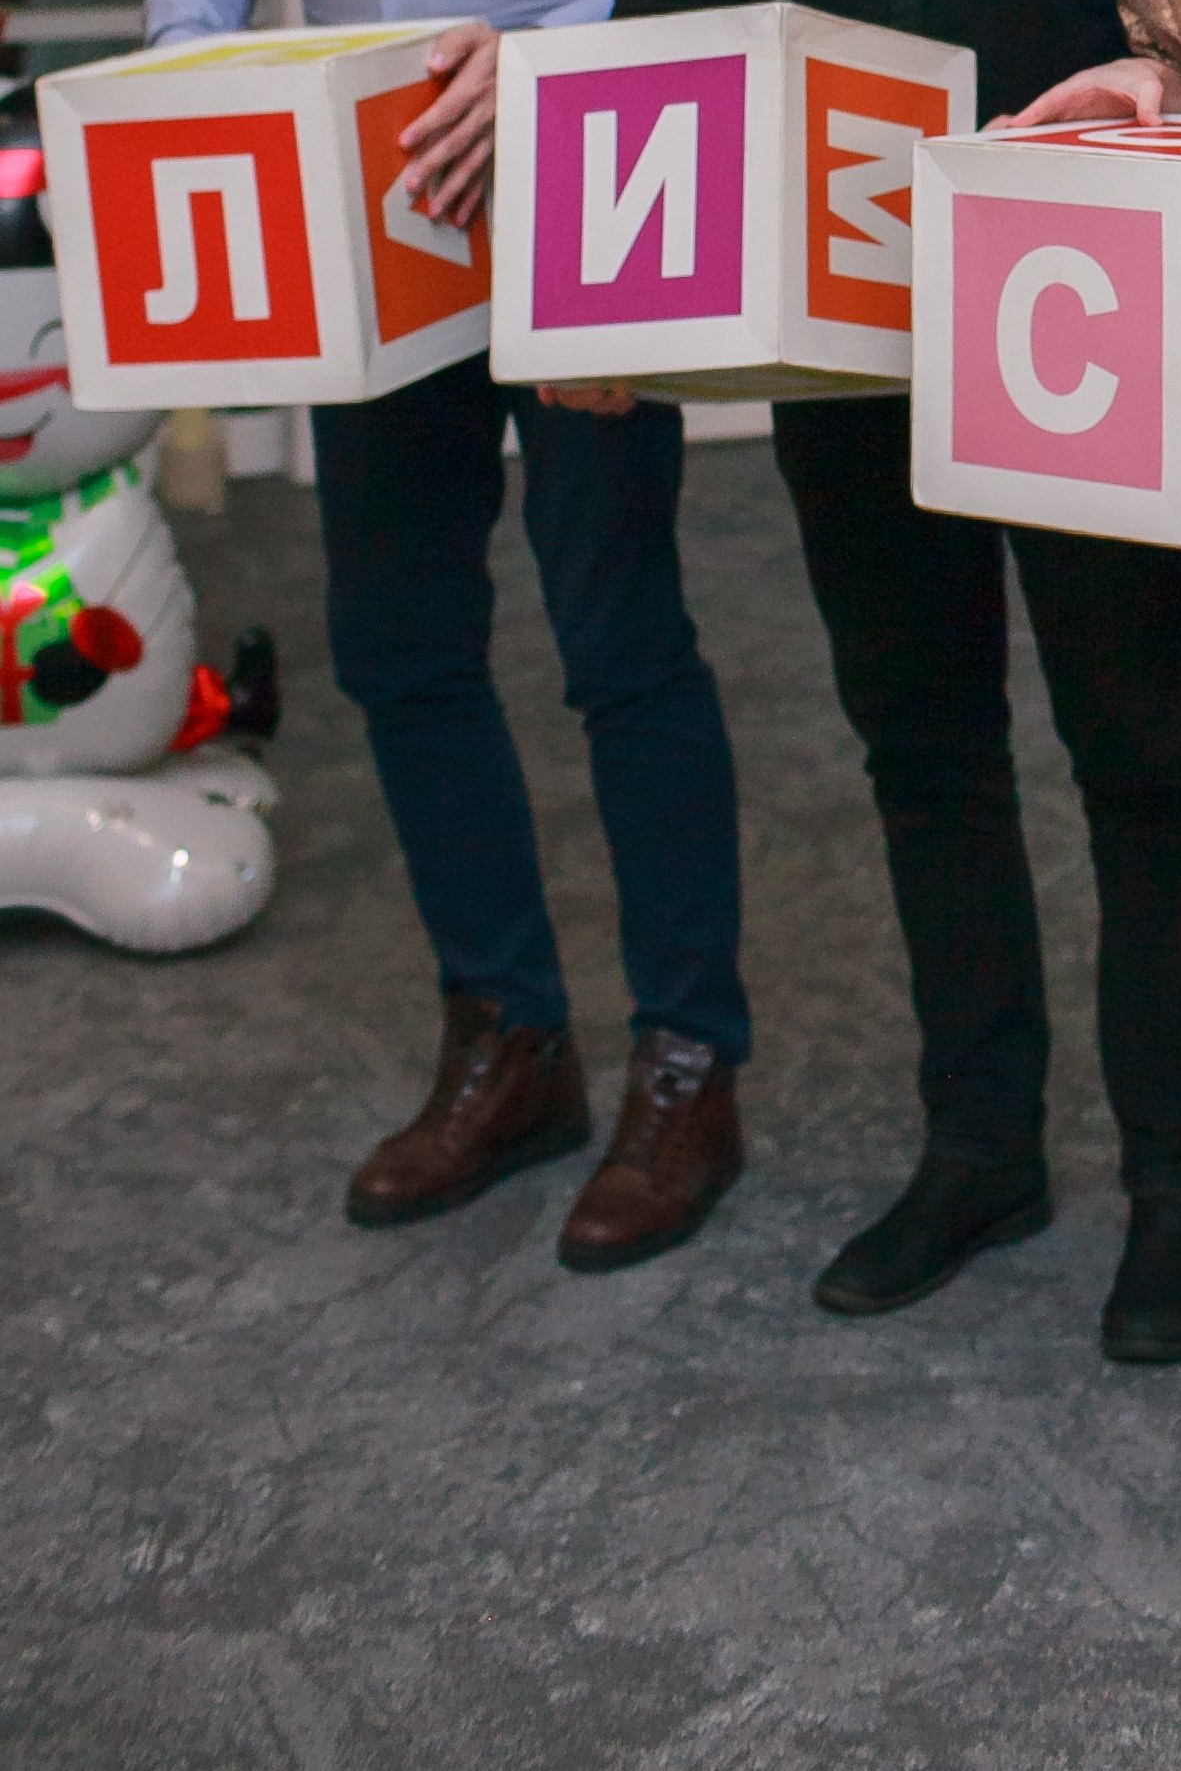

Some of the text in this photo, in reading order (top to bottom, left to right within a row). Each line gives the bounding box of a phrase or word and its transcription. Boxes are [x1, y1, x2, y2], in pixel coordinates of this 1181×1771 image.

[145, 154, 271, 325] Л
[580, 101, 697, 286] И
[997, 245, 1120, 434] С
